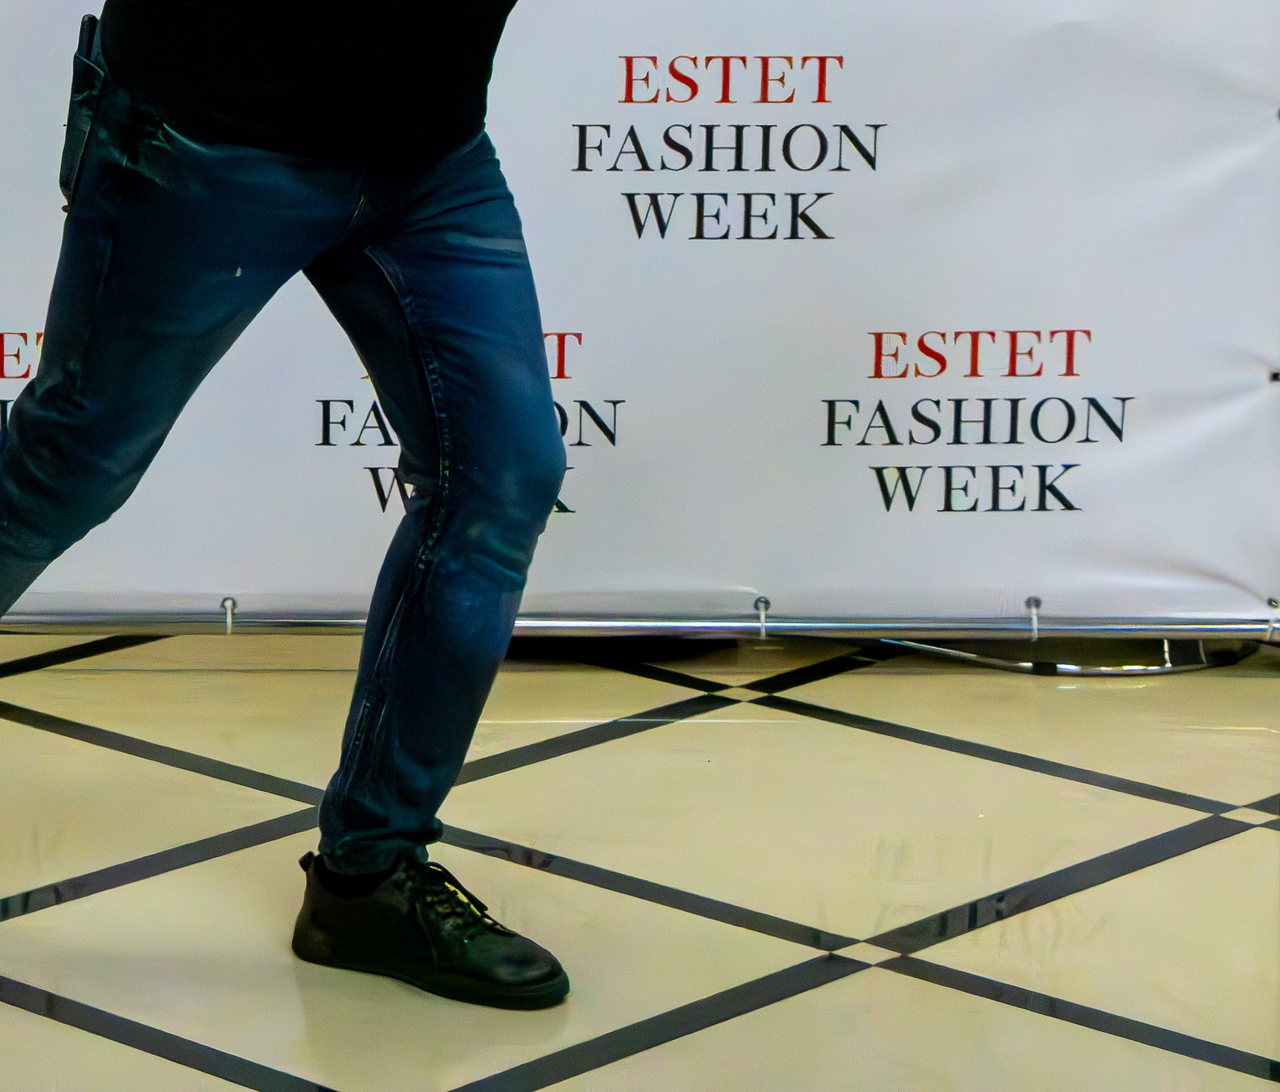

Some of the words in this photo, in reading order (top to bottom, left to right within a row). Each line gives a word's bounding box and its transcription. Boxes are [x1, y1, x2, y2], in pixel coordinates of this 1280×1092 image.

[618, 56, 843, 103] ESTET
[571, 124, 887, 172] FASHION
[621, 192, 834, 240] WEEK
[867, 330, 1091, 379] ESTET
[821, 397, 1134, 446] FASHION
[869, 464, 1082, 512] WEEK
